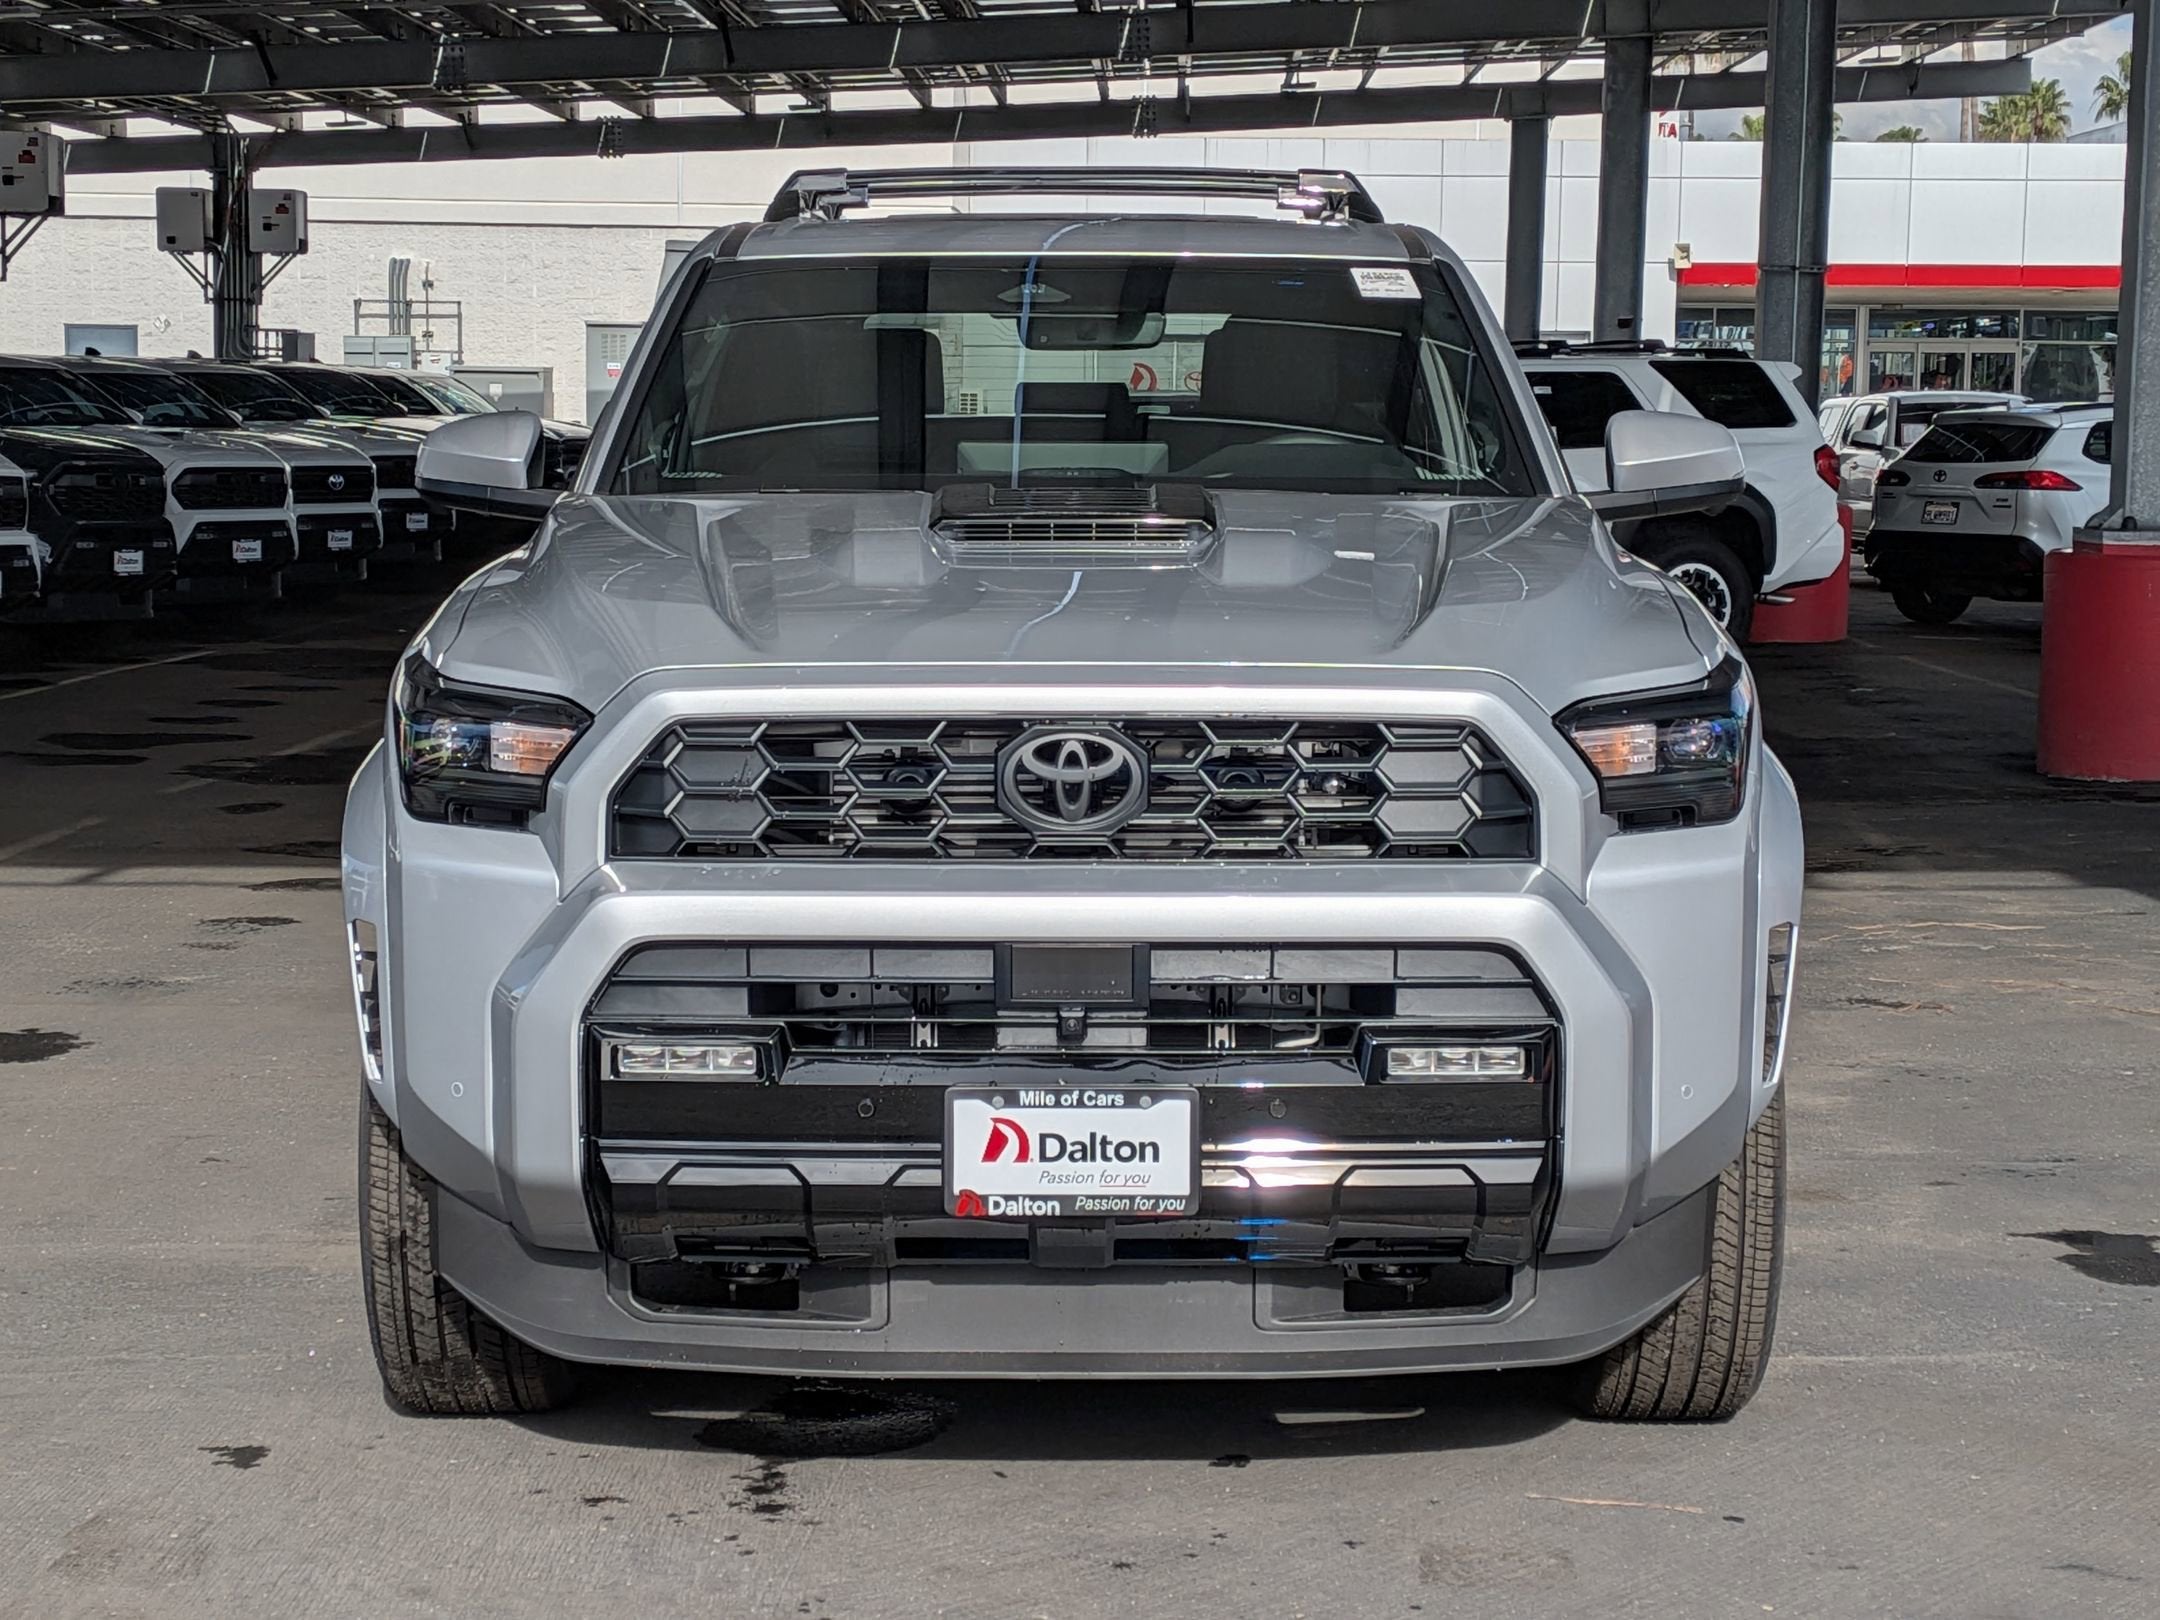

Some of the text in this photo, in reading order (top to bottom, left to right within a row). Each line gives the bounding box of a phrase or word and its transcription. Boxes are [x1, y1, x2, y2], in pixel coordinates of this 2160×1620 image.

[1019, 1091, 1125, 1107] Mile of Cars
[1038, 1131, 1160, 1163] Dalton
[1038, 1170, 1151, 1187] Passion for you
[988, 1196, 1061, 1216] Dalton
[1074, 1196, 1186, 1214] Passion for you
